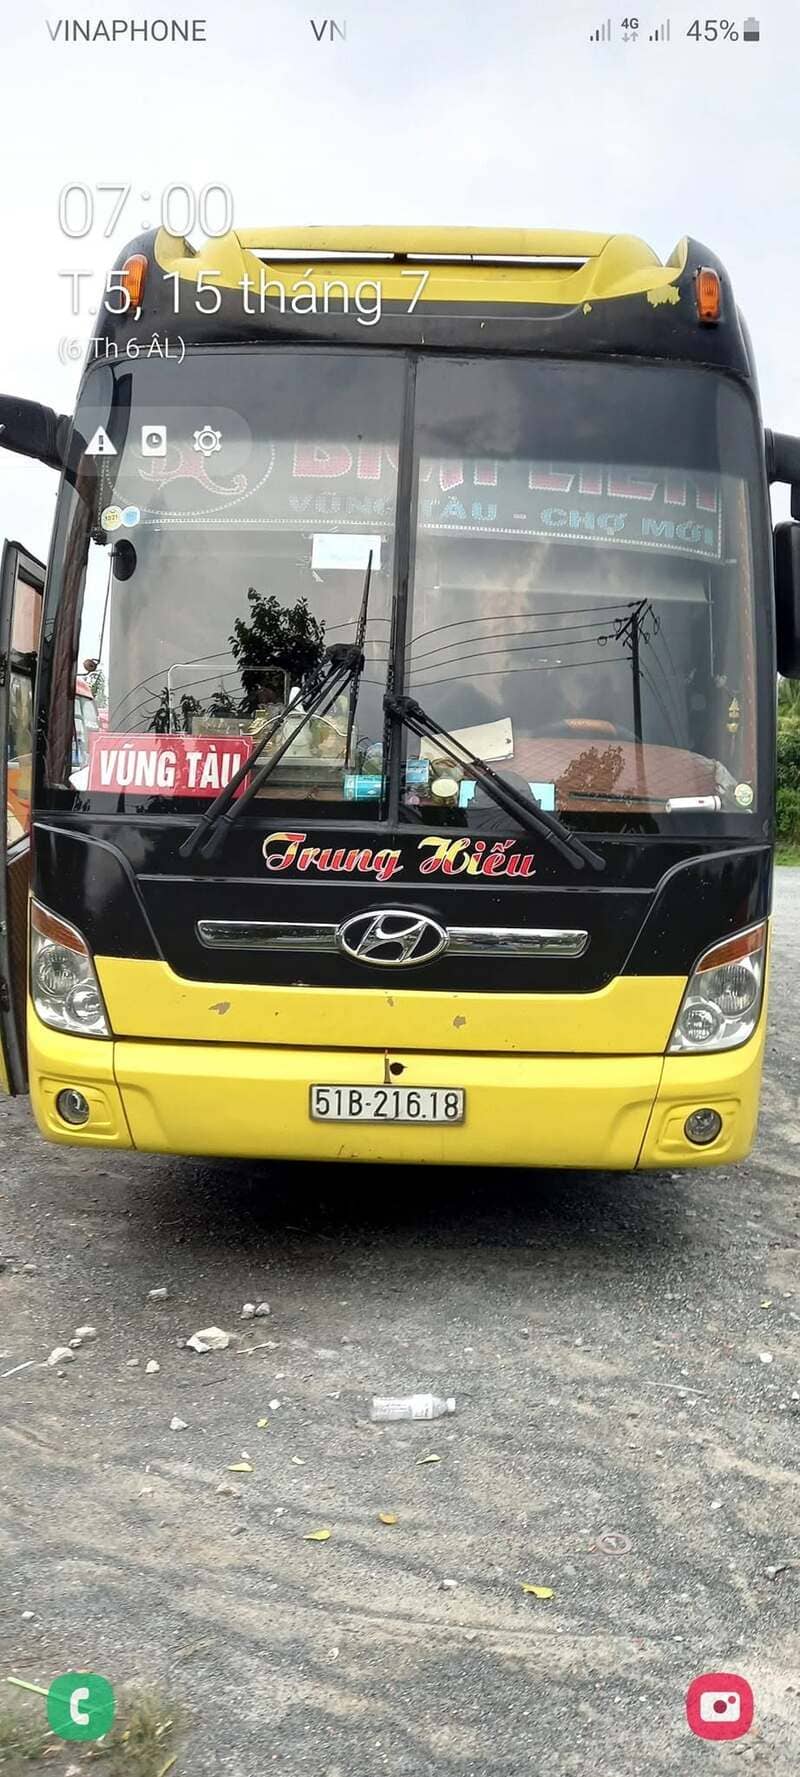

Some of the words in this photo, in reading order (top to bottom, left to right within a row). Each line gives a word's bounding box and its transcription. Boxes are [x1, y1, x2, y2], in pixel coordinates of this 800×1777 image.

[186, 745, 242, 790] TÀU
[263, 832, 403, 881] Trung
[418, 836, 536, 877] Hiếu
[315, 1089, 459, 1119] 51B-216.18
